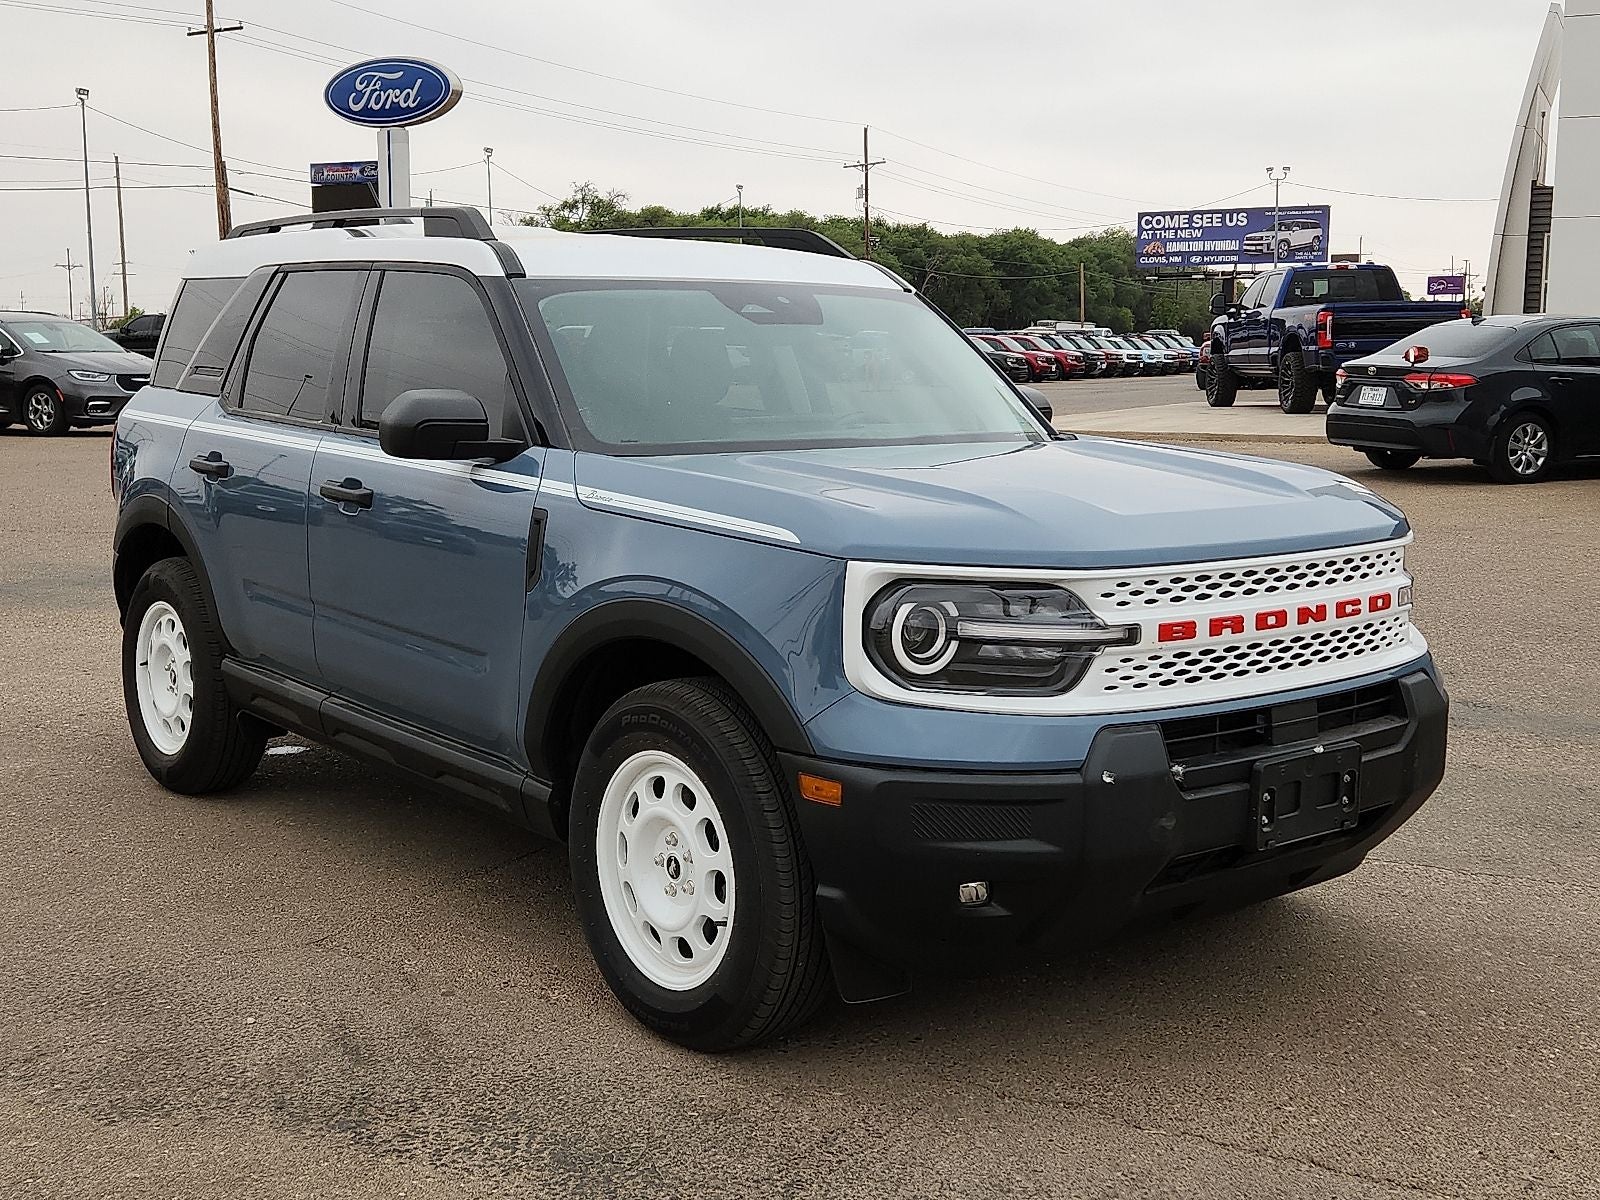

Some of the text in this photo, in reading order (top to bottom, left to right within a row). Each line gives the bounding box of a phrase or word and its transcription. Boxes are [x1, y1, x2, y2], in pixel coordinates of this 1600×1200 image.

[348, 71, 423, 112] Ford
[326, 172, 358, 182] COUNTRY
[1141, 212, 1248, 229] COME SEE US
[1140, 229, 1203, 239] AT THE NEW
[1166, 240, 1240, 253] HAMILTON HYUNDAI
[1140, 256, 1168, 264] CLOVIS,
[1169, 255, 1182, 263] NM
[1158, 592, 1391, 643] BRONCO
